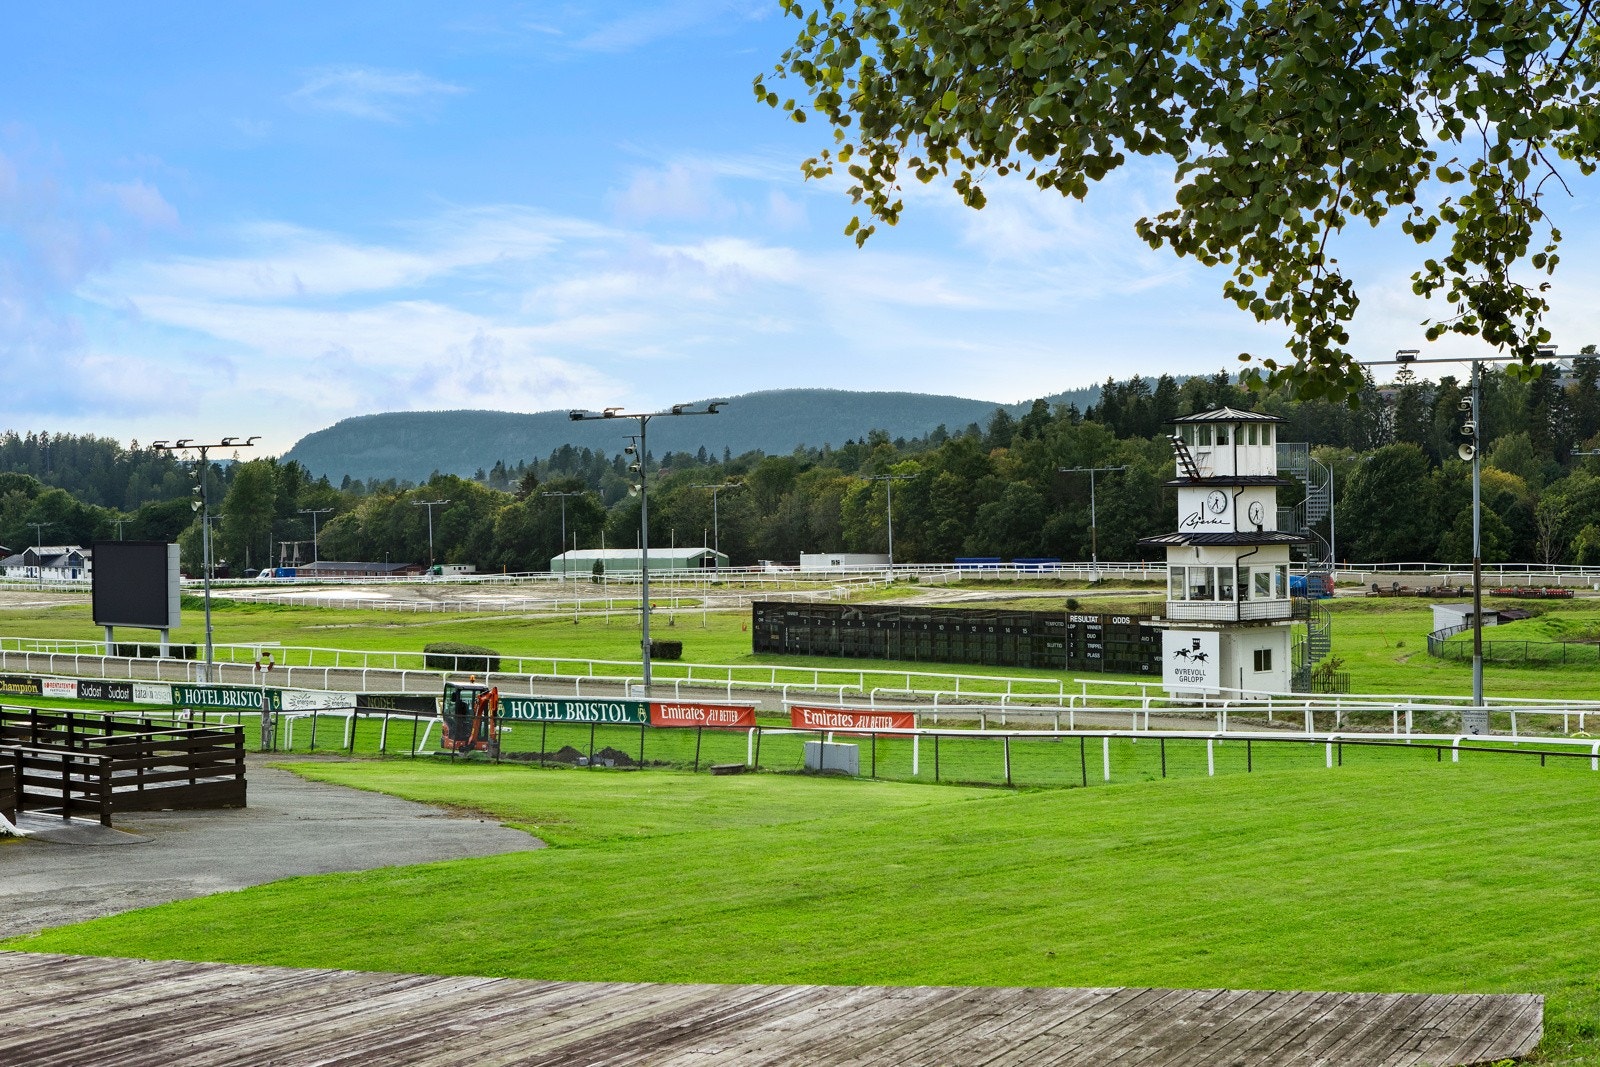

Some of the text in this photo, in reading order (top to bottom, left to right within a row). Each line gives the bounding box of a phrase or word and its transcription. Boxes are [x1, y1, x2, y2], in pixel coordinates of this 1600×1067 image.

[1174, 668, 1206, 676] ØVREVOLL
[1179, 675, 1204, 683] GALOPP
[185, 689, 263, 707] HOTEL BRISTO
[511, 701, 631, 722] HOTEL BRISTOL
[660, 704, 738, 722] Emirates FLY BETTER
[803, 709, 893, 728] Emirates FLY BETTER
